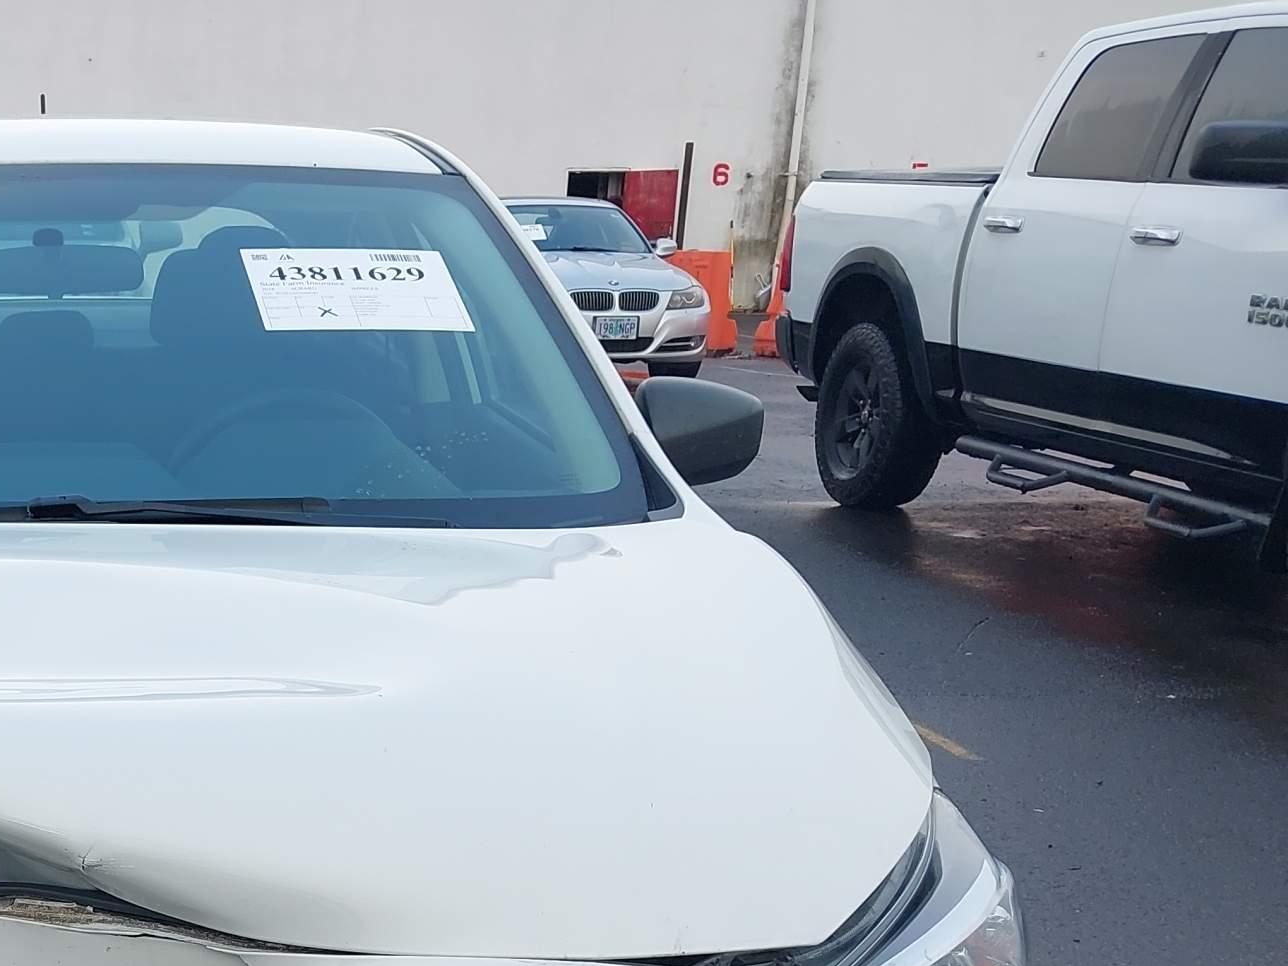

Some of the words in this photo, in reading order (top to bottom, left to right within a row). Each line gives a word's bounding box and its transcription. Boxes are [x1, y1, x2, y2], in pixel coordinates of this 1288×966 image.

[713, 163, 730, 186] 6
[269, 266, 425, 281] 43811629
[1247, 310, 1288, 328] 150
